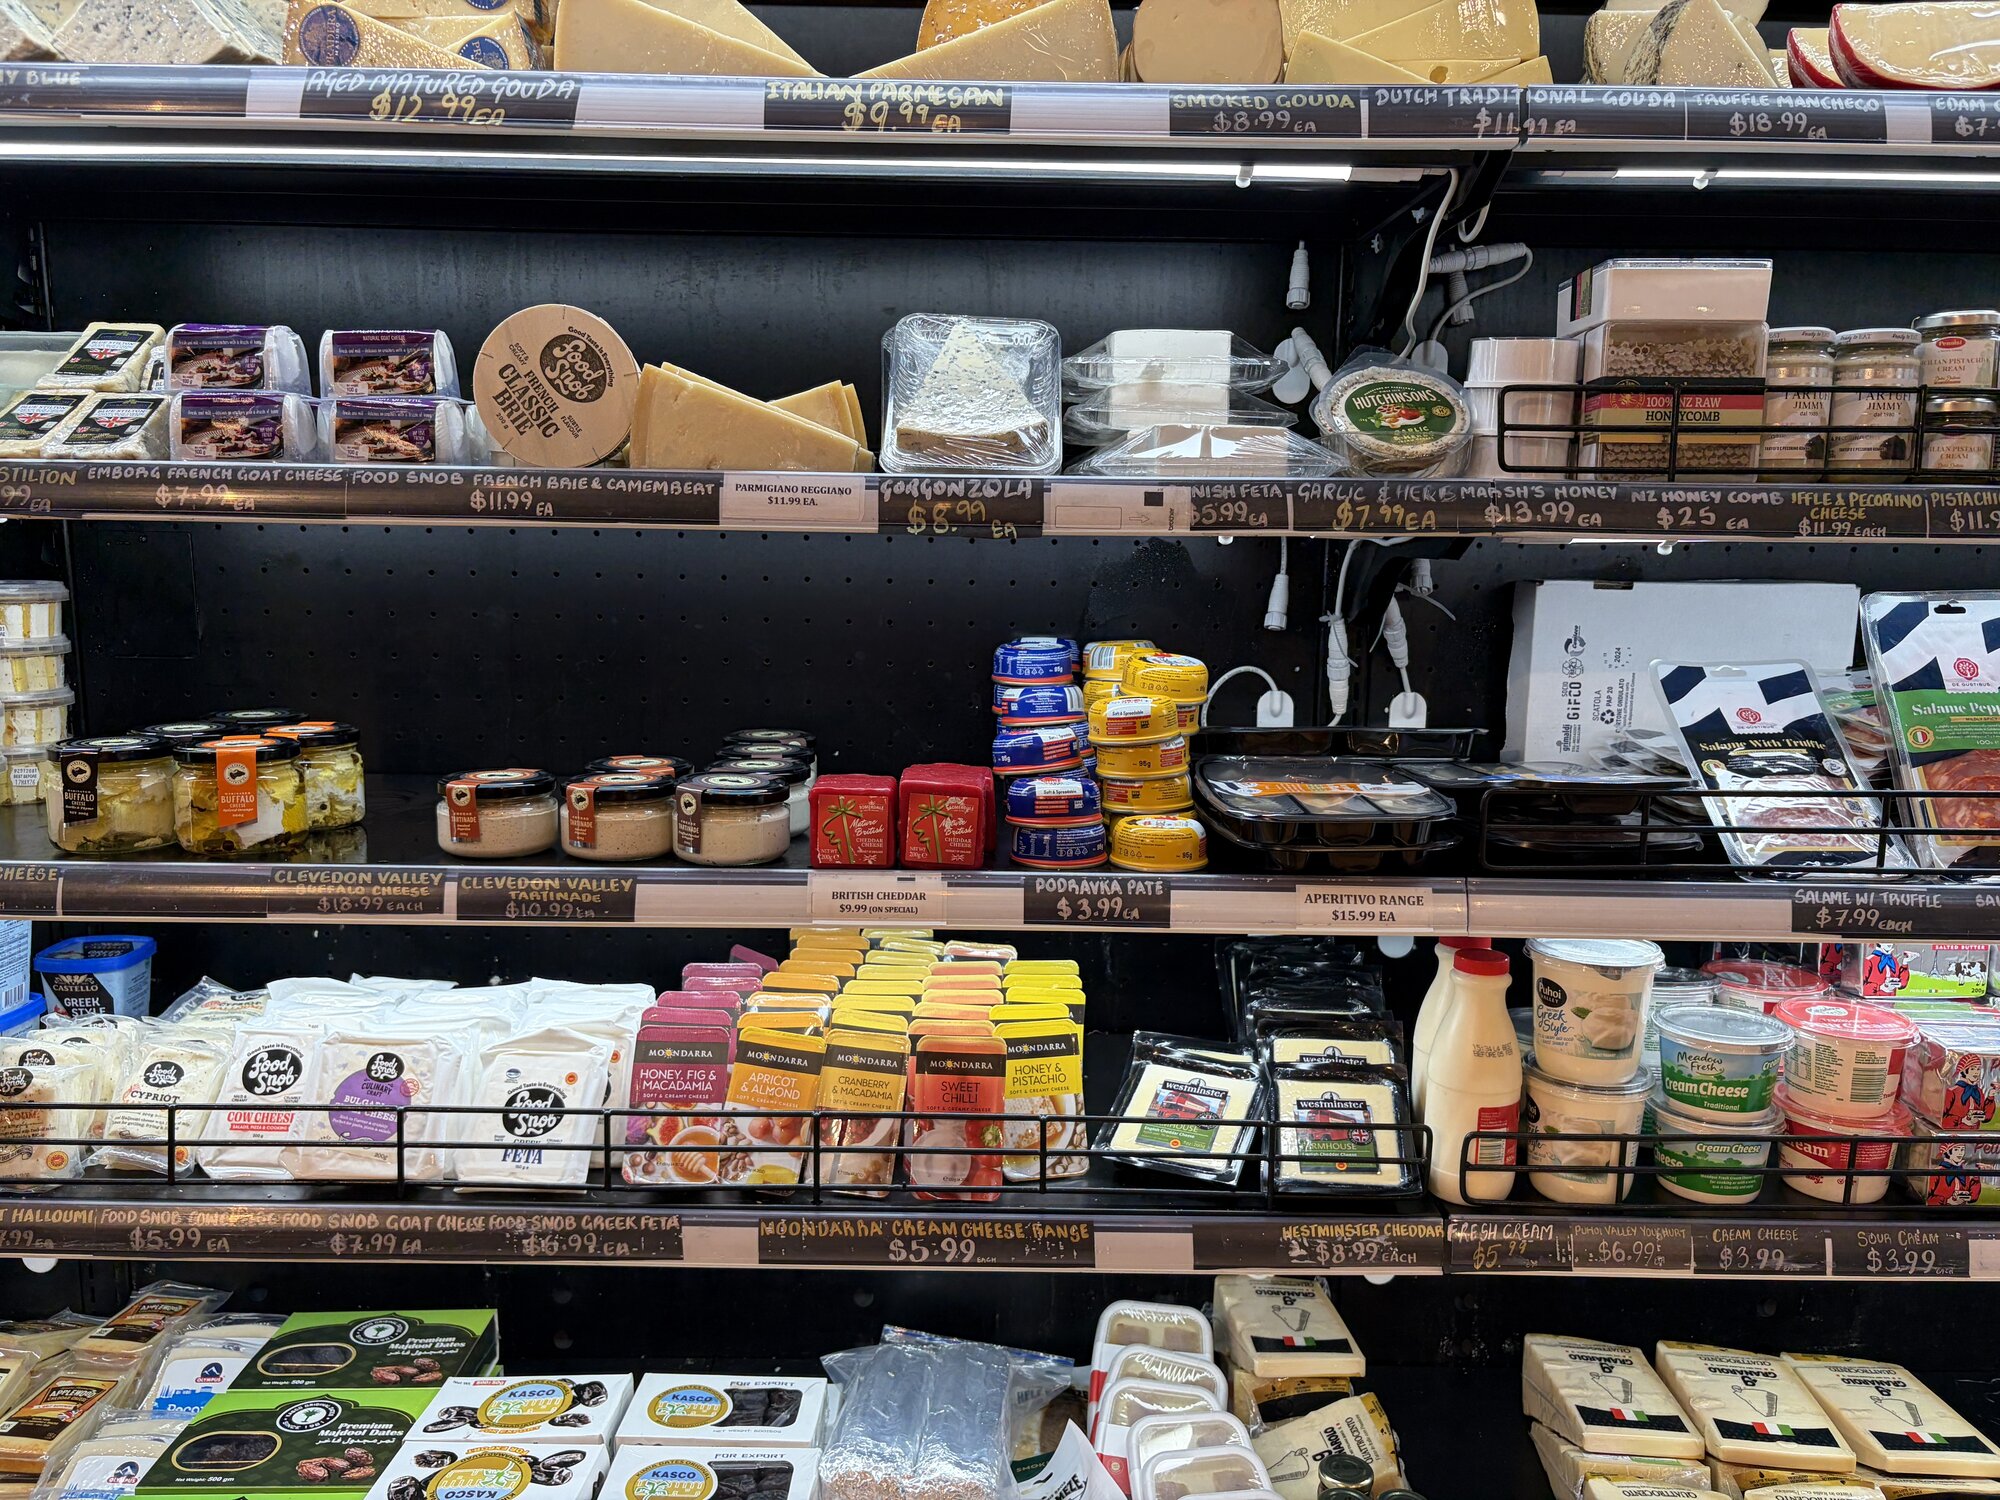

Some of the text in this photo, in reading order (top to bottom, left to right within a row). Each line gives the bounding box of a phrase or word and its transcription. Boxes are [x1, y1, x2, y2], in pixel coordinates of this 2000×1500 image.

[305, 70, 576, 99] AGED MATURED GOUDA
[766, 80, 1003, 107] ITALIAN PARMESAN
[1173, 93, 1356, 110] SMOKED GOUDA
[369, 93, 506, 126] $12.99 EA
[1696, 93, 1880, 111] TRUFFLE MANCHEGO
[1935, 97, 1986, 112] EDAM
[841, 101, 961, 133] $9.99 EA
[1729, 111, 1828, 140] $18.99 EA
[552, 339, 605, 383] Food
[545, 359, 596, 400] Snob
[524, 370, 560, 414] FRENCH
[1352, 389, 1437, 410] HUTCHINSONS
[498, 363, 561, 438] CLASSIC
[1866, 402, 1902, 411] JIMMY
[492, 388, 535, 436] BRIE
[87, 467, 343, 483] EMBORG FRENCH GOAT CHEESE
[351, 470, 715, 495] FOOD SNOB FRENCH BRIE & CAMEMBERT
[735, 483, 852, 497] PARMIGIANO REGGIANO
[880, 478, 1033, 500] GORGONZOLA
[1240, 483, 1282, 499] FETA
[1631, 490, 1658, 503] NZ
[1661, 489, 1722, 503] HONEY
[1727, 490, 1785, 504] COMB
[155, 485, 256, 512] $7.99 EA
[470, 488, 554, 517] $11.99 EA
[1332, 500, 1437, 532] $7.99 EA
[1656, 506, 1749, 530] $25 EA
[1810, 508, 1867, 521] CHEESE
[1614, 647, 1622, 663] 2024
[1606, 686, 1613, 696] 20
[1699, 738, 1826, 752] Salame With Truffle
[64, 792, 95, 802] BUFFALO
[220, 794, 255, 804] BUFFALO
[451, 815, 477, 823] TARTINADE
[274, 870, 444, 886] CLEVEDON VALLEY
[461, 876, 634, 893] CLEVEDON VALLEY
[1035, 877, 1164, 896] PODRAVKA PATE
[509, 889, 601, 902] TARTINADE
[832, 891, 927, 901] BRITISH CHEDDAR
[1304, 893, 1424, 906] APERITIVO RANGE
[1794, 888, 1942, 908] SALAME W/ TRUFFLE
[839, 903, 919, 915] $9.99 (ON SPECIAL)
[1056, 896, 1123, 920] $3.99
[1332, 909, 1396, 922] $15.99 EA
[53, 984, 99, 993] CASTELLO
[64, 997, 100, 1008] GREEK
[249, 1051, 291, 1078] Food
[1677, 1051, 1723, 1067] Meadow
[1690, 1060, 1719, 1074] Fresh
[1014, 1062, 1063, 1076] HONEY &
[255, 1071, 294, 1096] Snob
[361, 1081, 393, 1095] CULINARY
[643, 1080, 714, 1093] MACADAMIA
[748, 1072, 798, 1088] APRICOT
[838, 1075, 891, 1089] CRANBERRY
[941, 1081, 981, 1093] SWEET
[1012, 1073, 1068, 1087] PISTACHIO
[740, 1081, 801, 1100] & ALMOND
[831, 1085, 894, 1101] & MACADAMIA
[1165, 1080, 1228, 1099] westminster
[1665, 1077, 1750, 1100] Cream Cheese
[130, 1090, 181, 1104] CYPRIOT
[942, 1092, 979, 1104] CHILLI
[1299, 1099, 1366, 1110] westminster
[1703, 1100, 1741, 1112] Traditional
[501, 1149, 543, 1165] FETA
[1696, 1143, 1762, 1155] Cream Cheese
[12, 1208, 94, 1224] HALLOUMI
[282, 1213, 323, 1228] FOOD
[328, 1213, 380, 1229] SNOB
[386, 1214, 433, 1233] GOAT
[436, 1215, 486, 1233] CHEESE
[489, 1214, 680, 1231] FOOD SNOB GREEK FETA
[892, 1220, 957, 1238] CREAM
[961, 1221, 1026, 1240] CHEESE
[1031, 1222, 1090, 1243] RANGE
[1282, 1222, 1444, 1240] WESTMINSTER CHEDDAR
[1712, 1228, 1799, 1244] CREAM CHEESE
[1857, 1231, 1940, 1247] SOUR CREAM
[389, 1341, 466, 1351] Majdool Dates
[406, 1336, 457, 1344] Premium
[195, 1376, 224, 1384] OLYMPUS
[730, 1380, 796, 1388] FOR EXPORT
[508, 1388, 557, 1399] KASCO
[672, 1393, 713, 1403] KASCO
[318, 1428, 404, 1438] Majdool Dates
[337, 1422, 394, 1430] Premium
[715, 1452, 787, 1460] FOR EXPORT
[652, 1469, 697, 1479] KASCO
